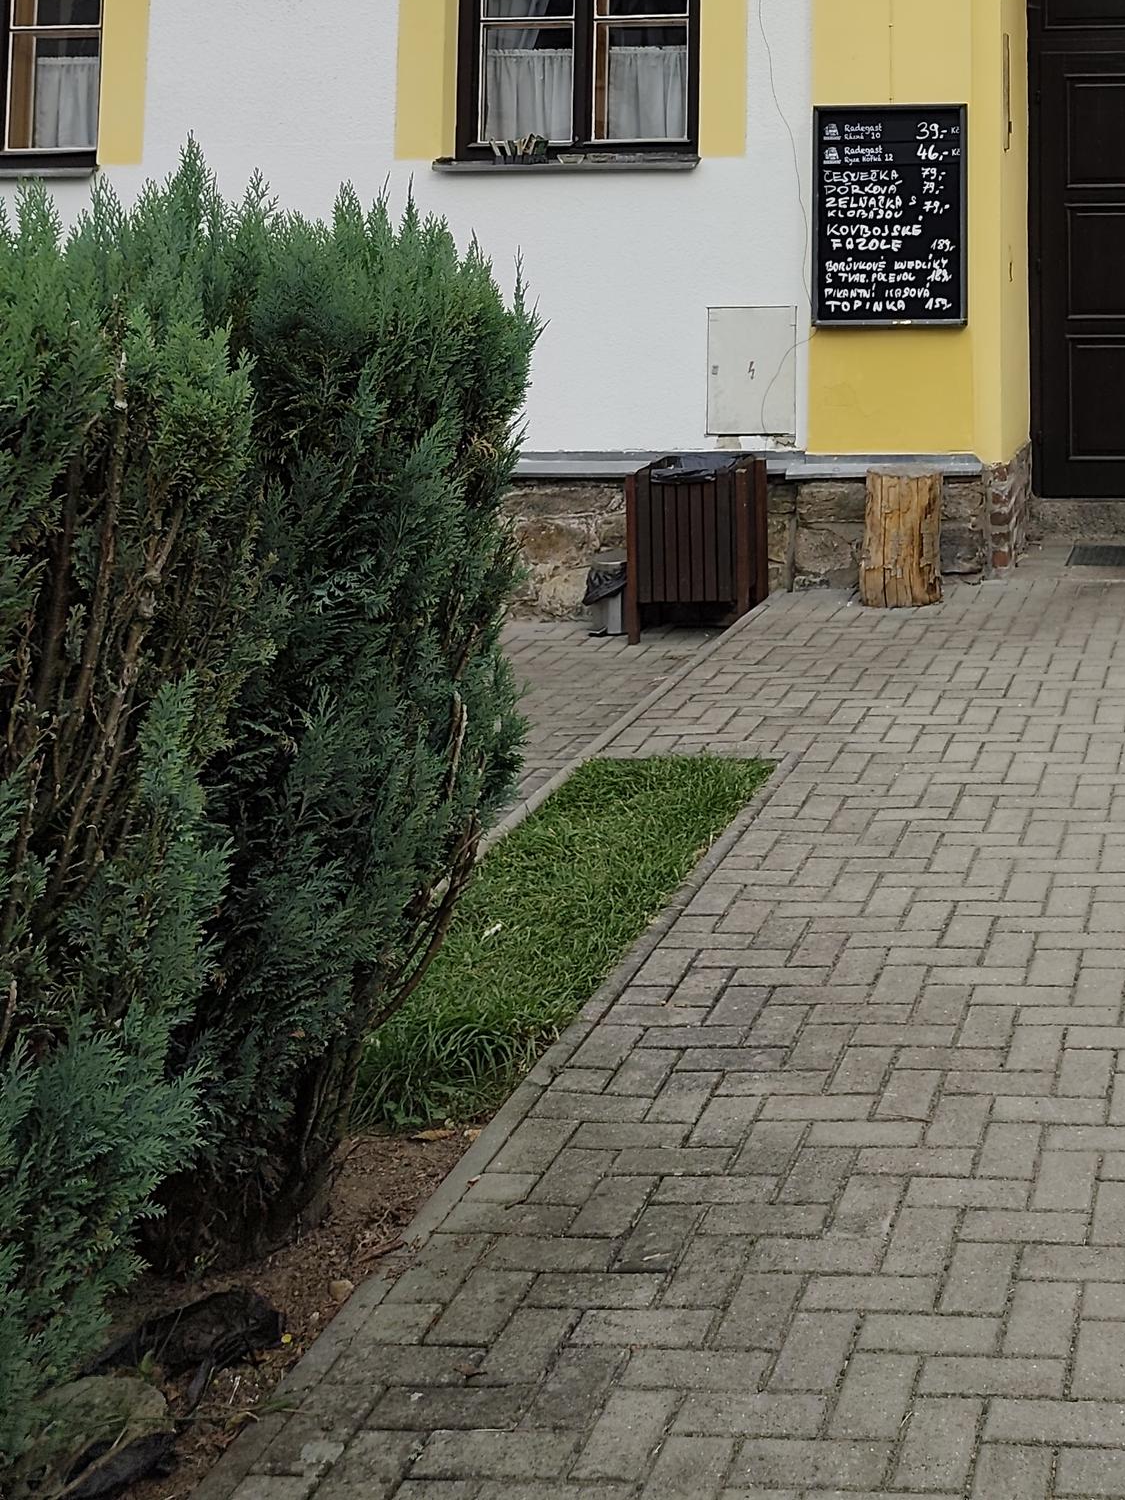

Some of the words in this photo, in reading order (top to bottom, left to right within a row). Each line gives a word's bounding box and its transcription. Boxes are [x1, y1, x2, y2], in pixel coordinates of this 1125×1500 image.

[844, 123, 883, 135] Radegast
[844, 145, 883, 157] Radegast
[884, 153, 894, 161] 12
[830, 238, 903, 252] FAZOLE
[825, 300, 906, 312] TOPINKA
